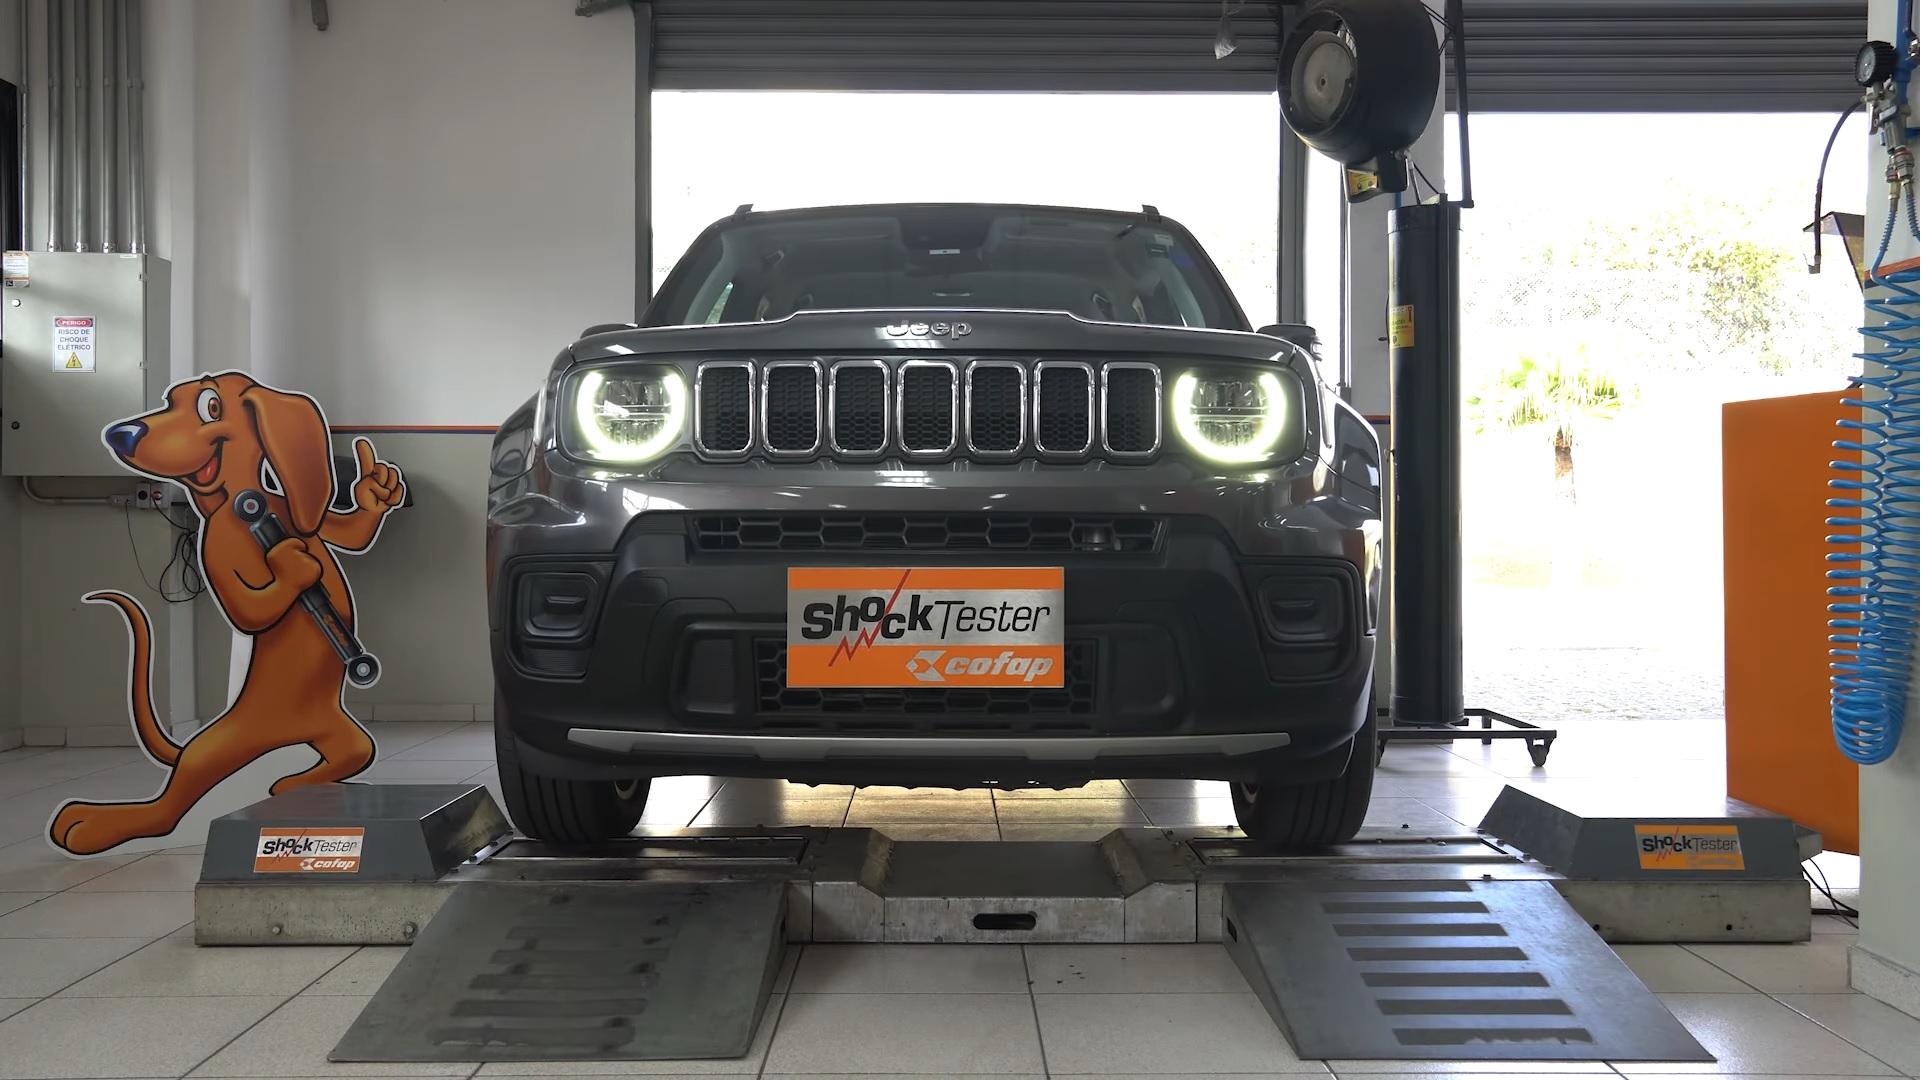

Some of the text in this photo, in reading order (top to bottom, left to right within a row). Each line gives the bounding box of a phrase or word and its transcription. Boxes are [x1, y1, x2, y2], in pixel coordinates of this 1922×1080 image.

[886, 320, 972, 340] Jeep
[944, 651, 1054, 682] cofap
[314, 858, 356, 870] cofap
